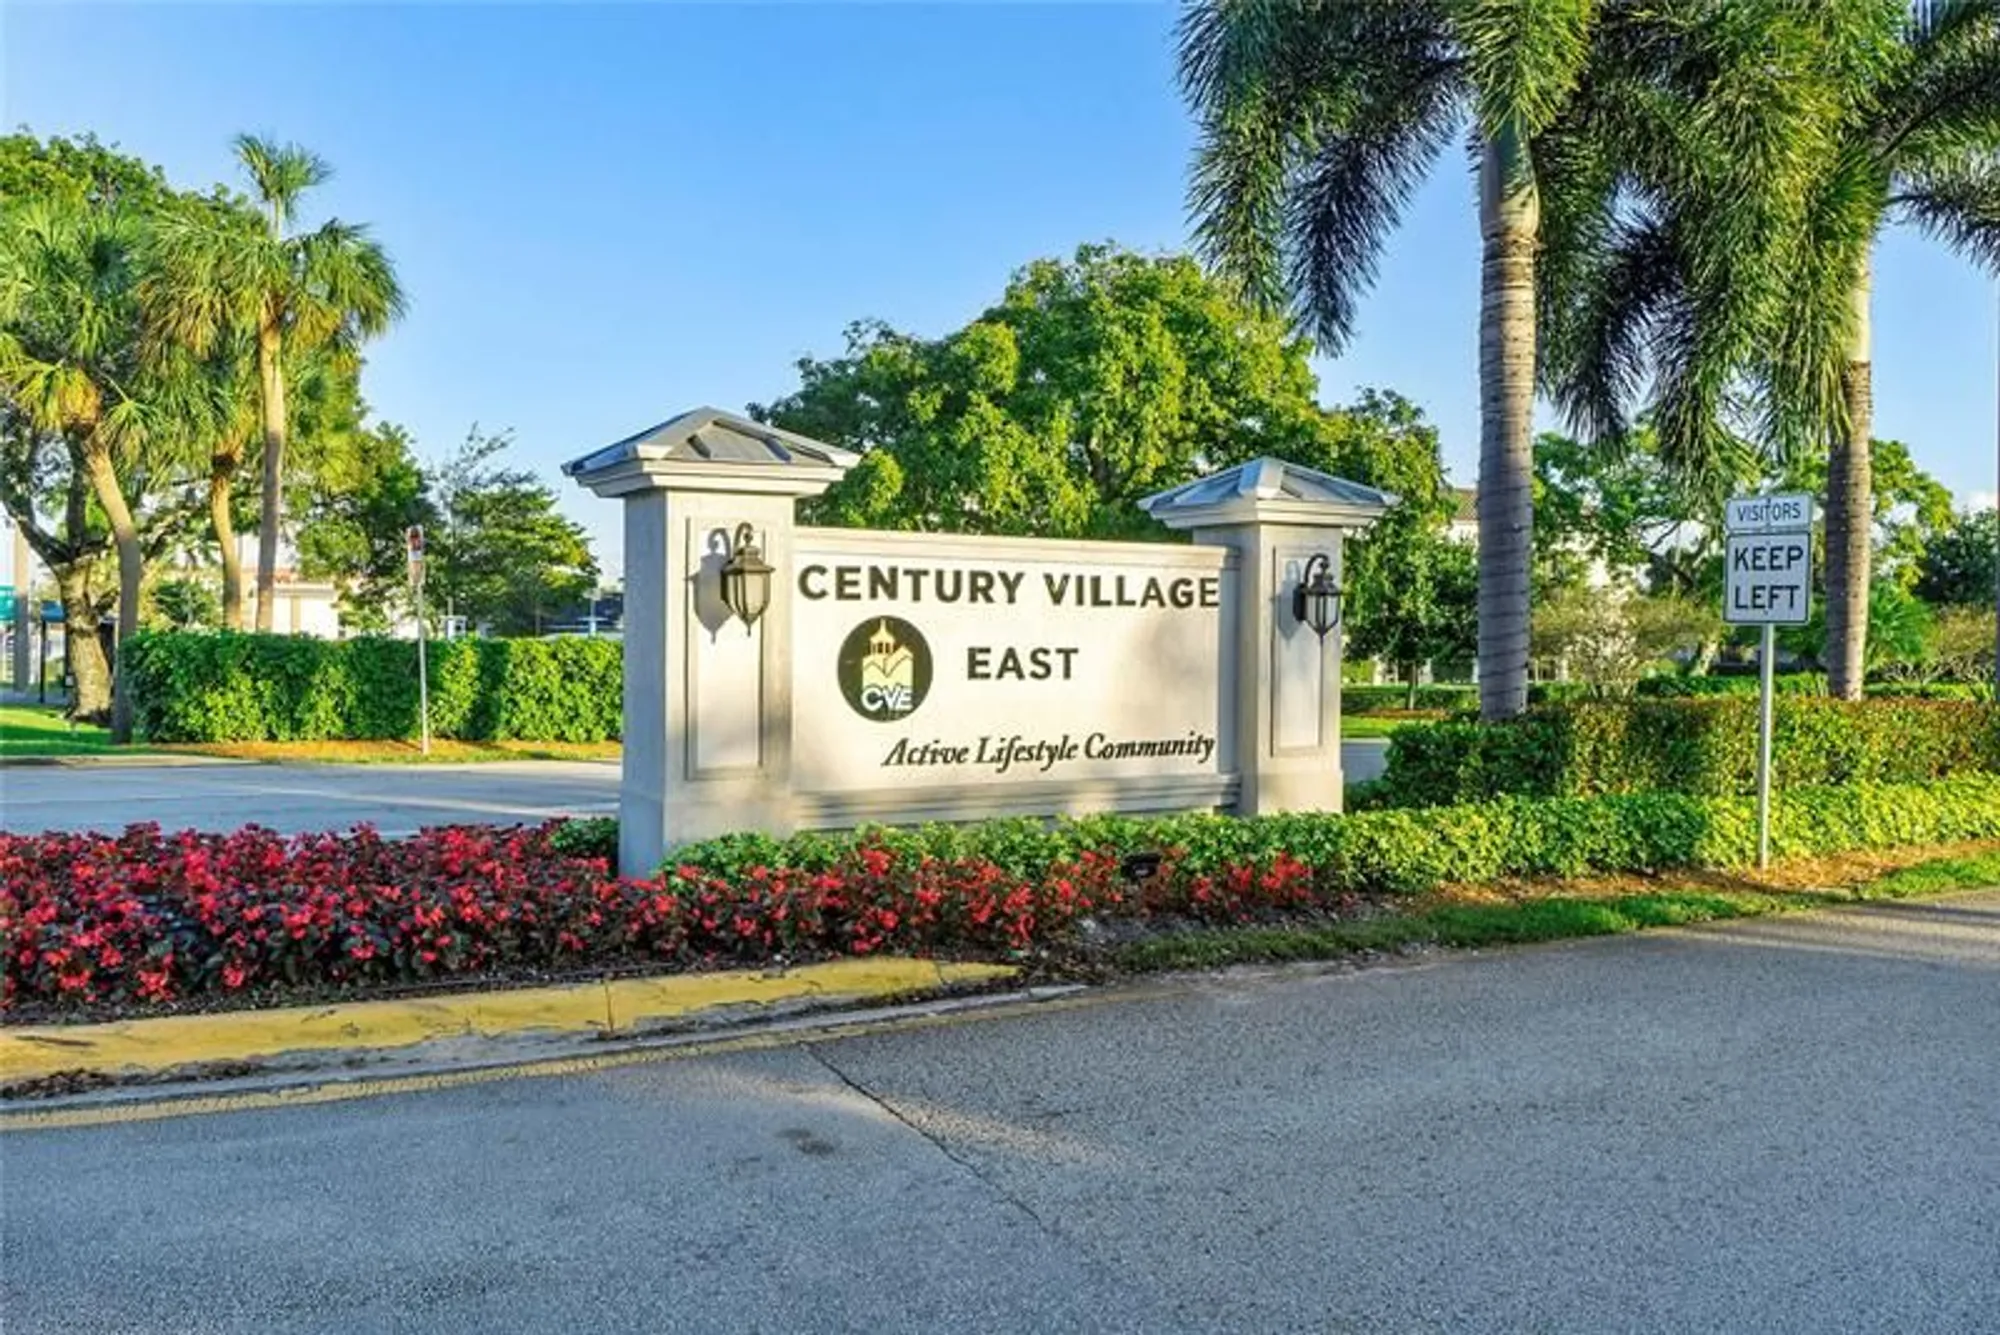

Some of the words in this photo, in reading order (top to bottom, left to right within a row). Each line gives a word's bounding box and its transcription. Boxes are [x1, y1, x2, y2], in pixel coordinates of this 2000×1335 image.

[1737, 502, 1801, 521] VISITORS
[1734, 545, 1804, 571] KEEP
[797, 564, 1027, 605] CENTURY
[1043, 573, 1220, 608] VILLAGE
[1734, 584, 1801, 609] LEFT
[966, 647, 1080, 681] EAST
[861, 685, 913, 712] CVE
[881, 736, 969, 767] Active
[975, 734, 1079, 773] Lifestyle
[1084, 731, 1216, 764] Community
